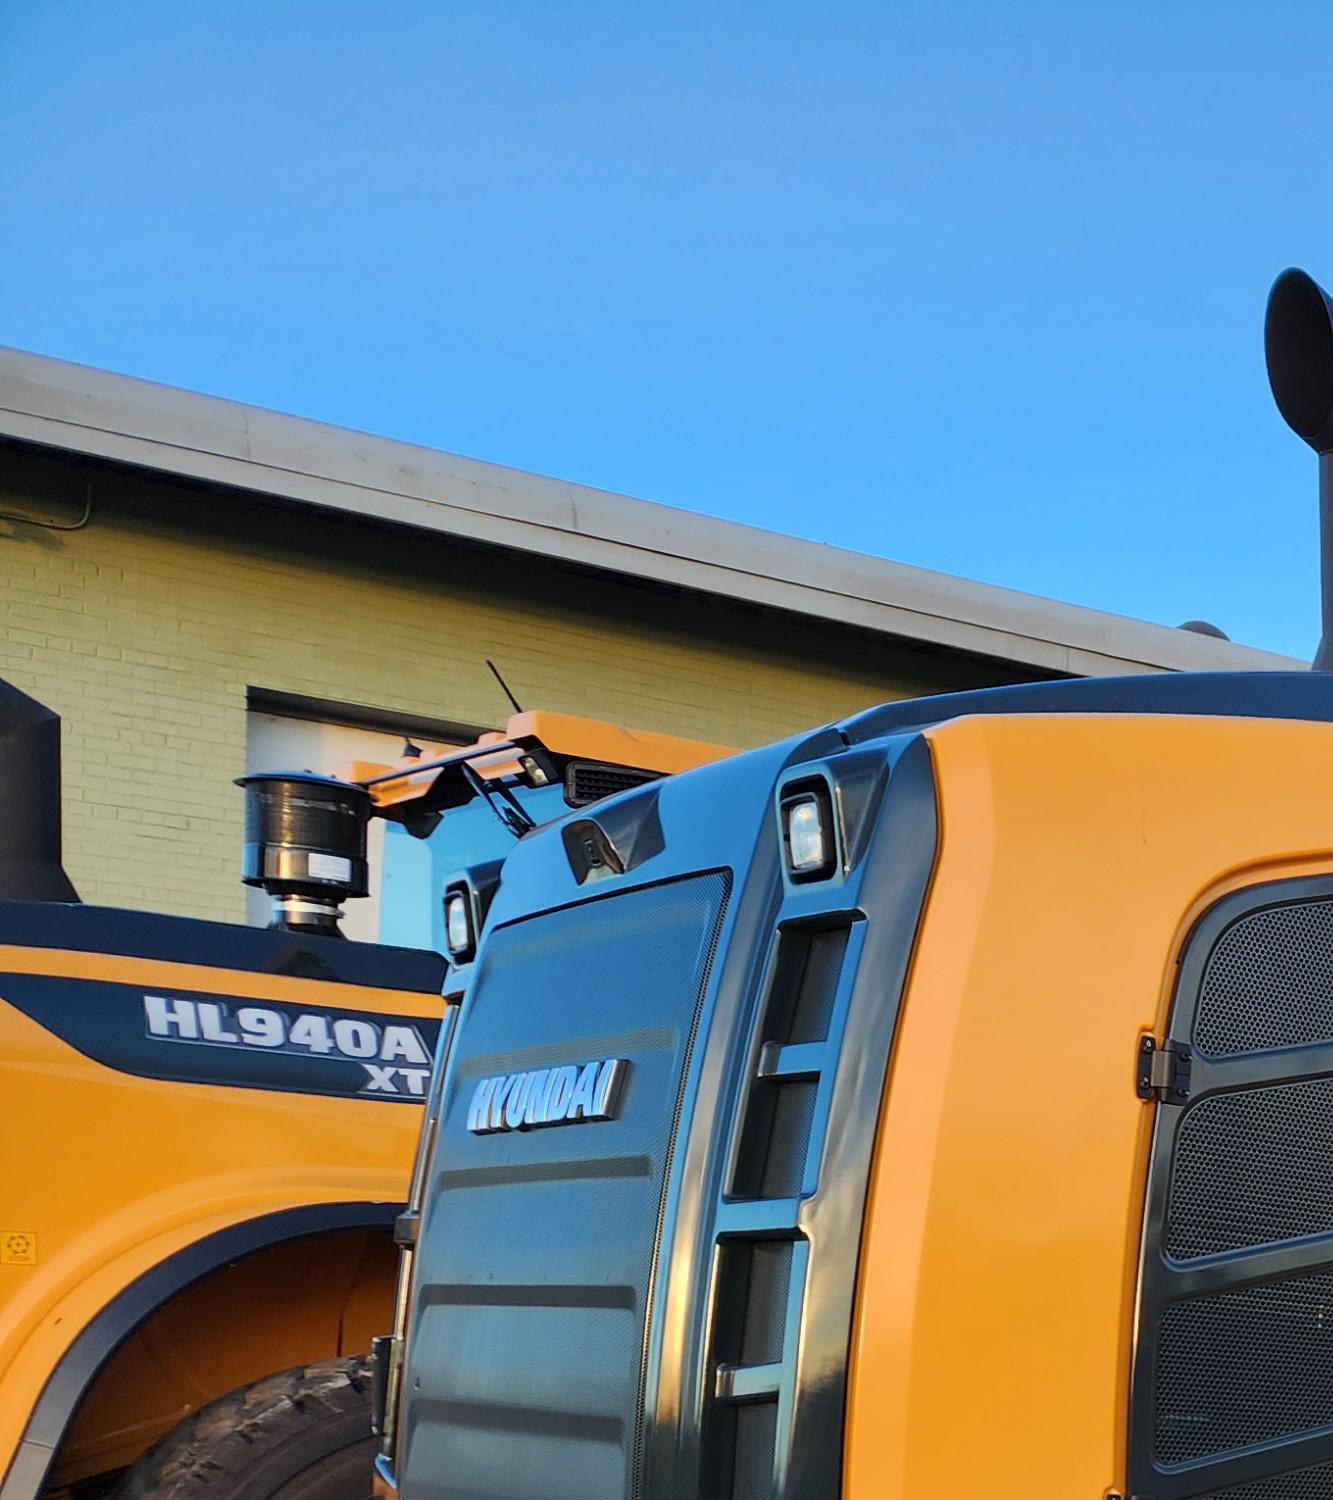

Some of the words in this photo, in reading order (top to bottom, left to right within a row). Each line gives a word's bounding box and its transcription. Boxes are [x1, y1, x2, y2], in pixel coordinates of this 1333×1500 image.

[144, 996, 428, 1064] HL940A
[363, 1064, 431, 1094] XT
[467, 1059, 617, 1130] HYUNDAI
